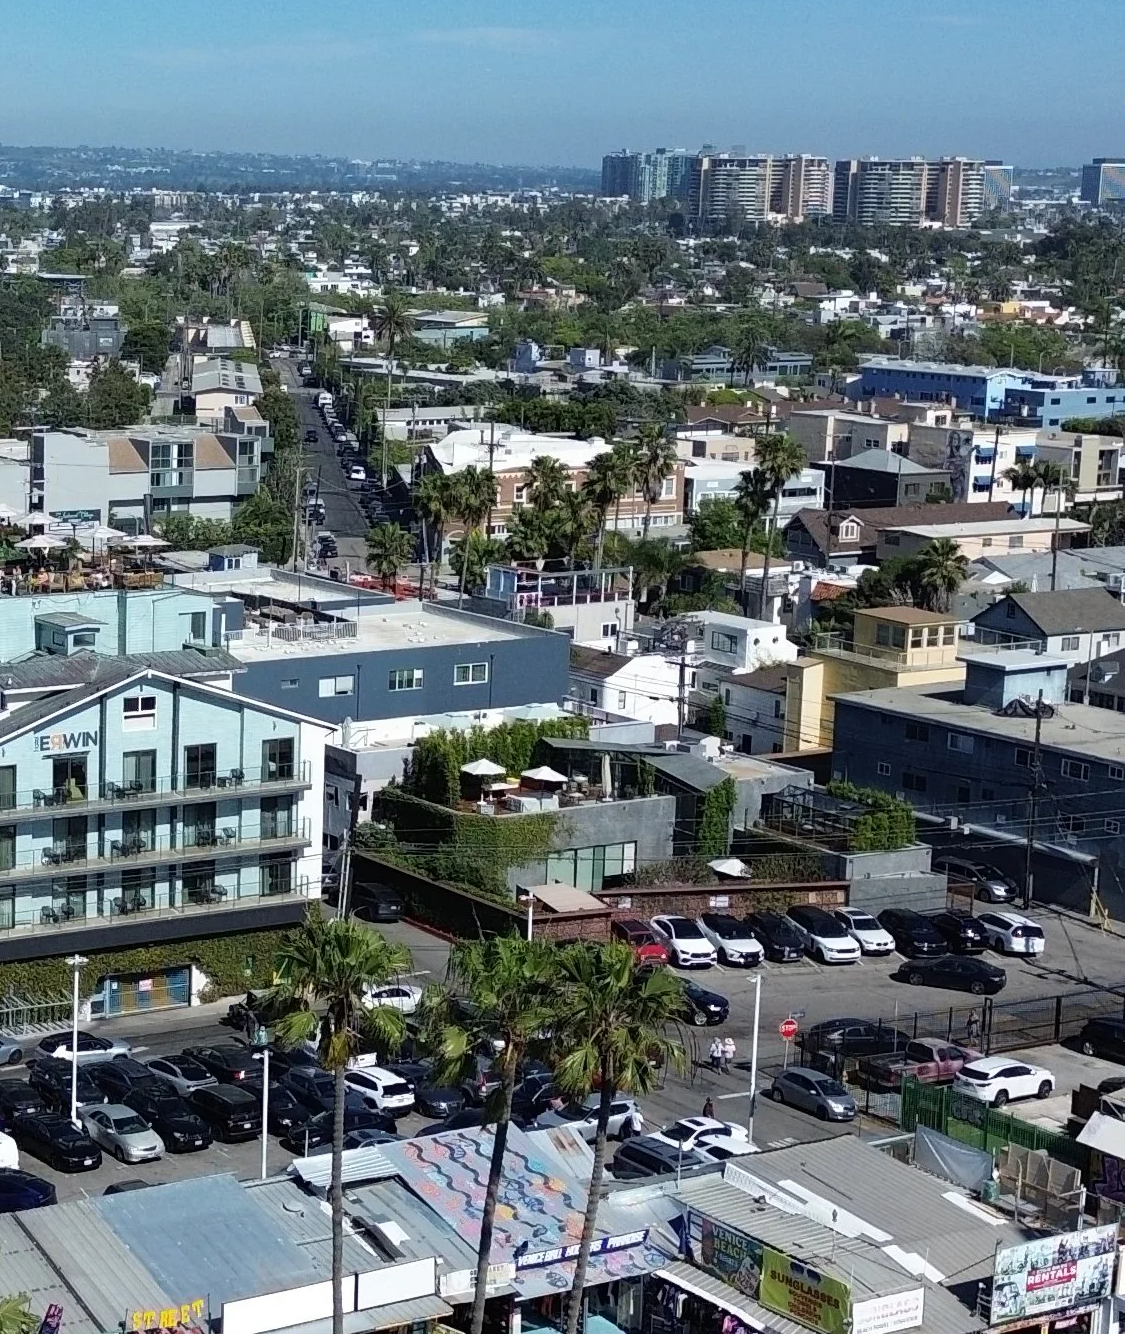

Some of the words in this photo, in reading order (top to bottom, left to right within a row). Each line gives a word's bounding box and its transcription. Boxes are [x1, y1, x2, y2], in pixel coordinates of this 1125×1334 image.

[39, 731, 98, 751] ERWIN
[712, 1224, 748, 1251] VENICE
[714, 1237, 747, 1260] BEACH
[518, 1253, 545, 1267] VENICE
[1028, 1266, 1077, 1286] RENTALS
[770, 1270, 840, 1310] SUNGLASSES
[132, 1299, 204, 1330] STREET
